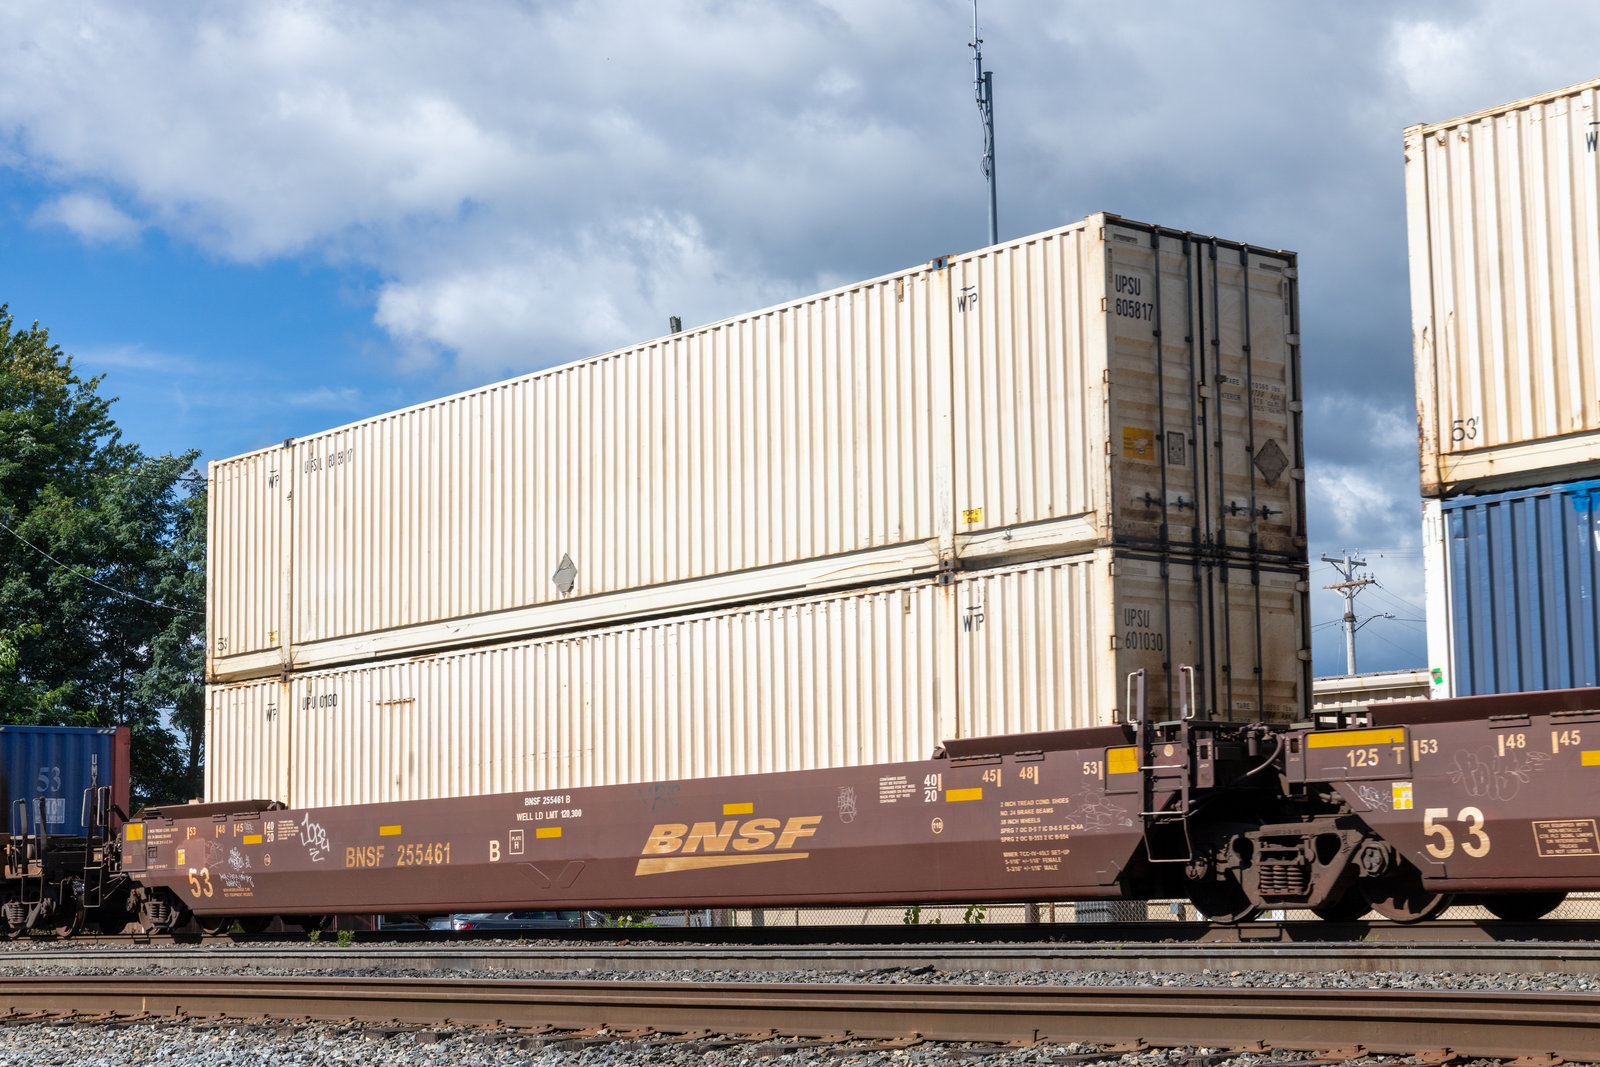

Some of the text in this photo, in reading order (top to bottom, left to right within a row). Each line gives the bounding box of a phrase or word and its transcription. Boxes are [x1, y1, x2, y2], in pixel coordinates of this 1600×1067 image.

[1115, 274, 1141, 296] UPSU
[1116, 298, 1153, 321] 605817
[1124, 608, 1150, 628] UPSU
[1125, 631, 1163, 651] 601030
[1506, 734, 1526, 749] 48
[1560, 730, 1581, 746] 45
[1420, 739, 1438, 754] 53
[1347, 747, 1405, 767] 125 T
[982, 770, 996, 782] 45
[1019, 766, 1033, 779] 48
[1083, 762, 1098, 775] 53
[37, 766, 61, 792] 53
[924, 774, 937, 786] 40
[525, 795, 570, 806] BNSF 255461 B
[924, 790, 937, 802] 20
[516, 812, 533, 821] WELL
[535, 812, 543, 820] LD
[546, 810, 558, 819] LMT
[189, 826, 196, 836] 53
[237, 823, 244, 832] 45
[267, 821, 274, 830] 40
[1423, 806, 1491, 859] 53
[267, 833, 274, 842] 20
[642, 816, 822, 855] BNSF
[490, 840, 500, 861] B
[514, 841, 519, 849] H
[346, 842, 450, 868] BNSF 255461
[188, 867, 214, 898] 53
